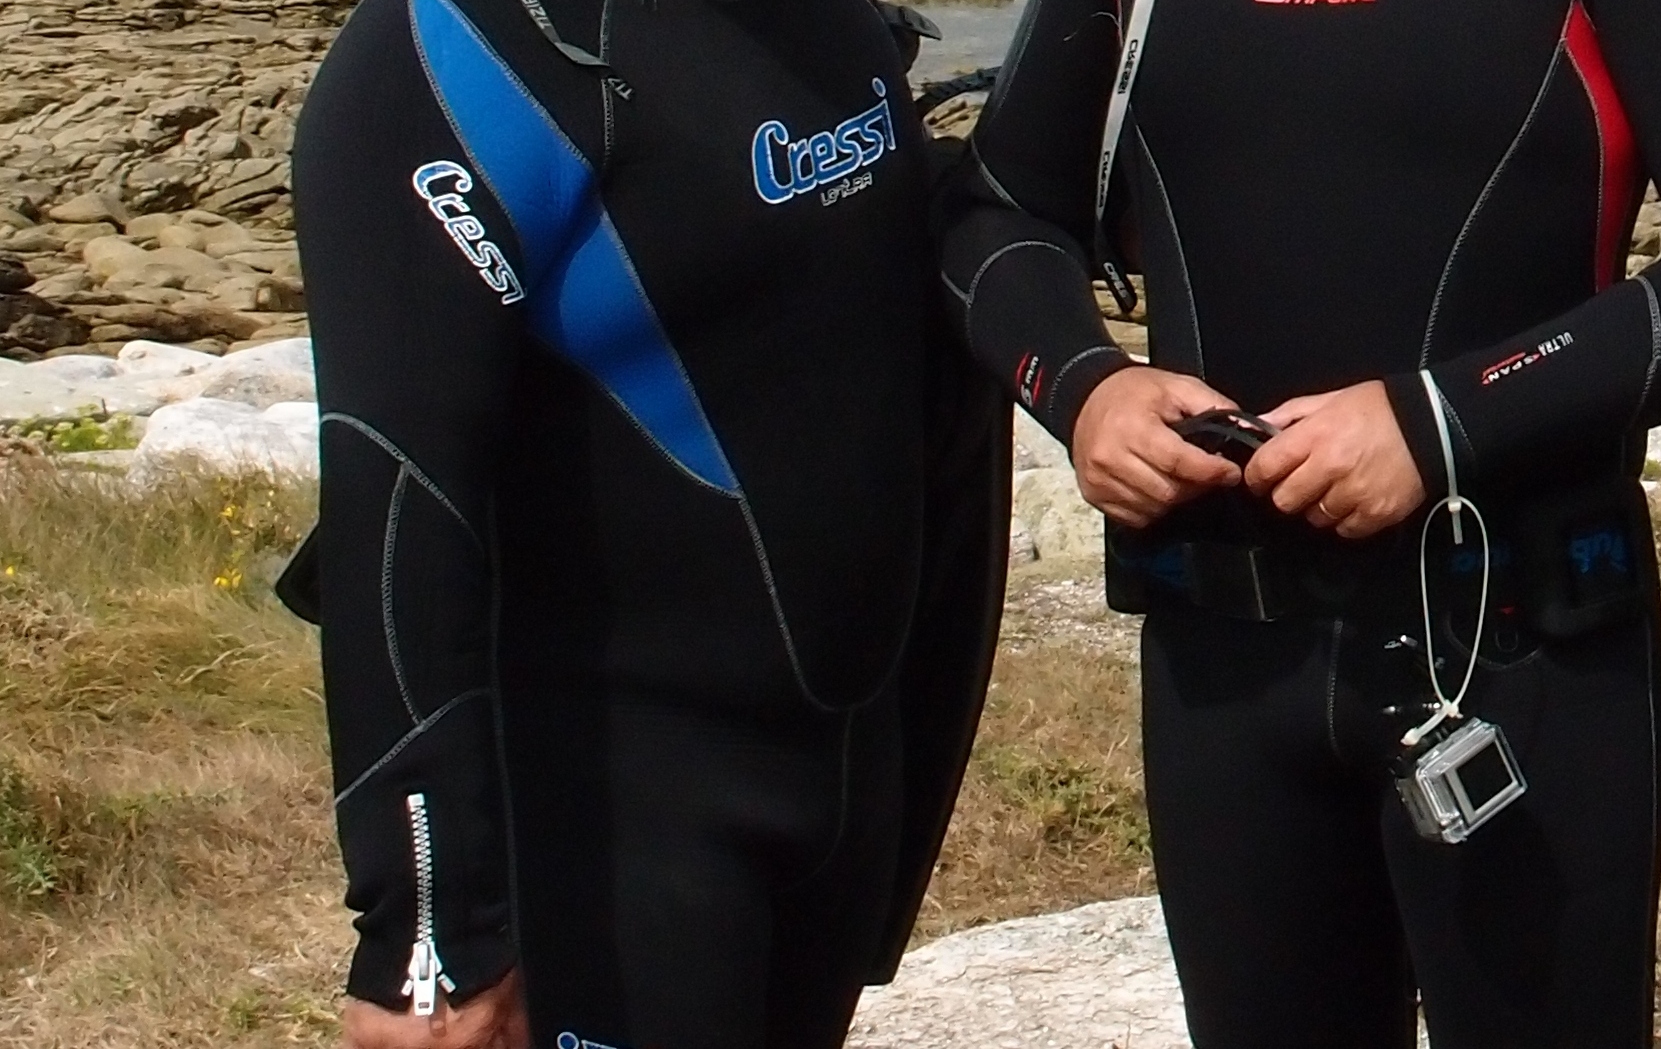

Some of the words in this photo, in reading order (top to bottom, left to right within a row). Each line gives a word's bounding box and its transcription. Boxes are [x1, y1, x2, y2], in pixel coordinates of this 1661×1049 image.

[751, 76, 897, 205] Cressi
[412, 159, 527, 306] Cressi
[1537, 331, 1574, 357] ULTRA
